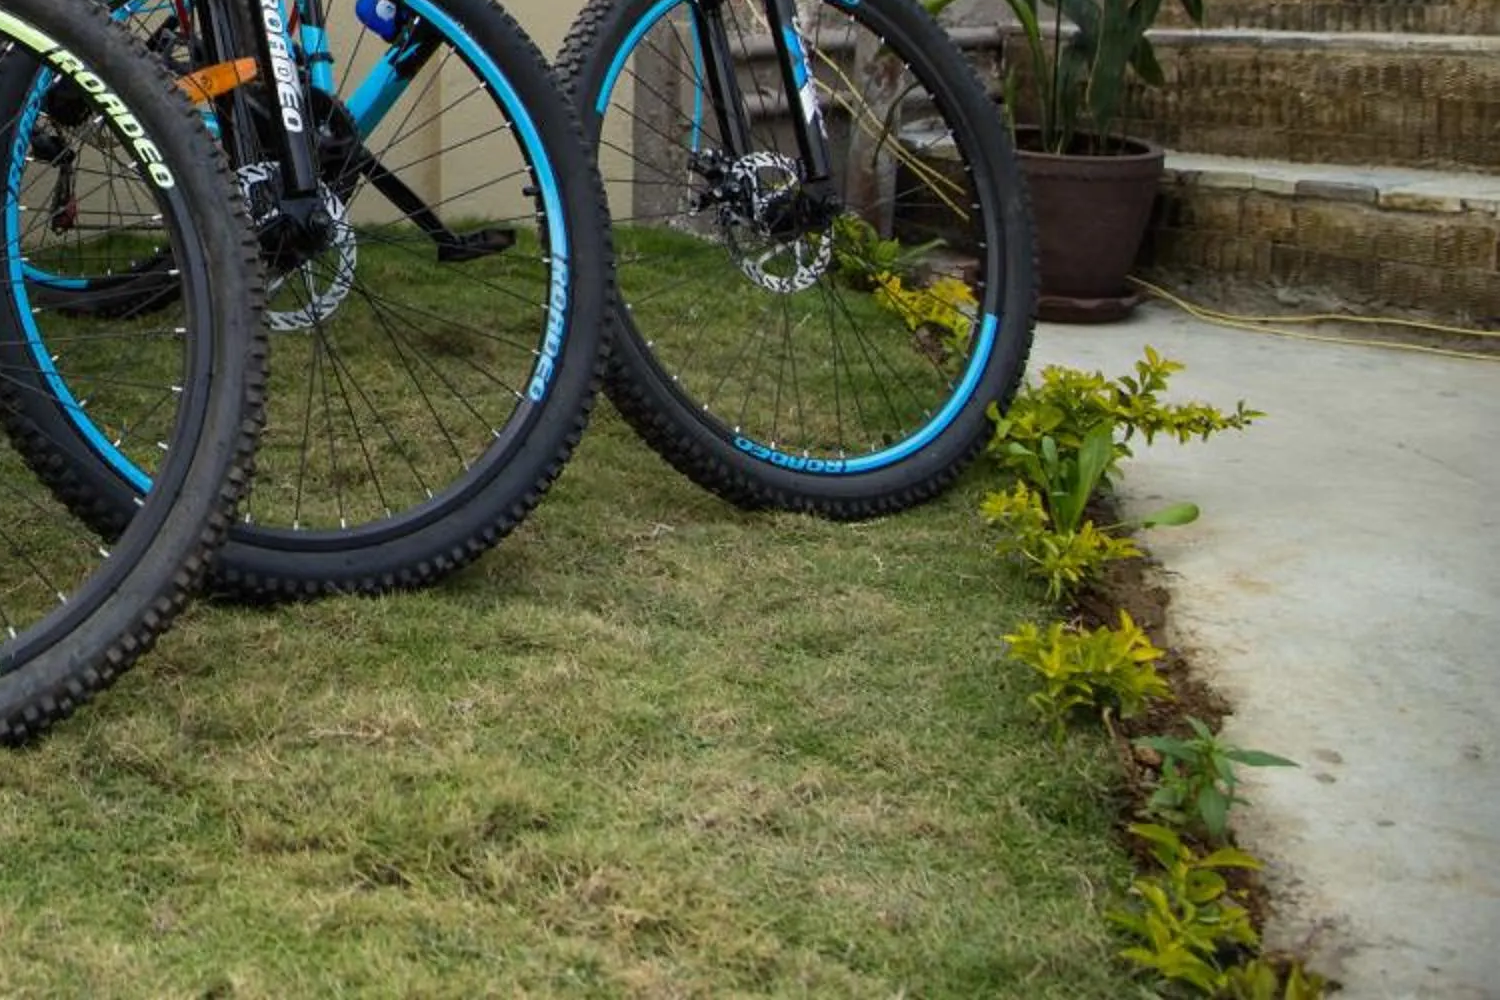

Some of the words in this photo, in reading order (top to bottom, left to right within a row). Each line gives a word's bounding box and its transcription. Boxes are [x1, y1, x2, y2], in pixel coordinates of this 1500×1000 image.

[48, 49, 176, 189] ROADEO
[529, 254, 568, 401] ROADEO
[733, 437, 845, 473] ROADEO
